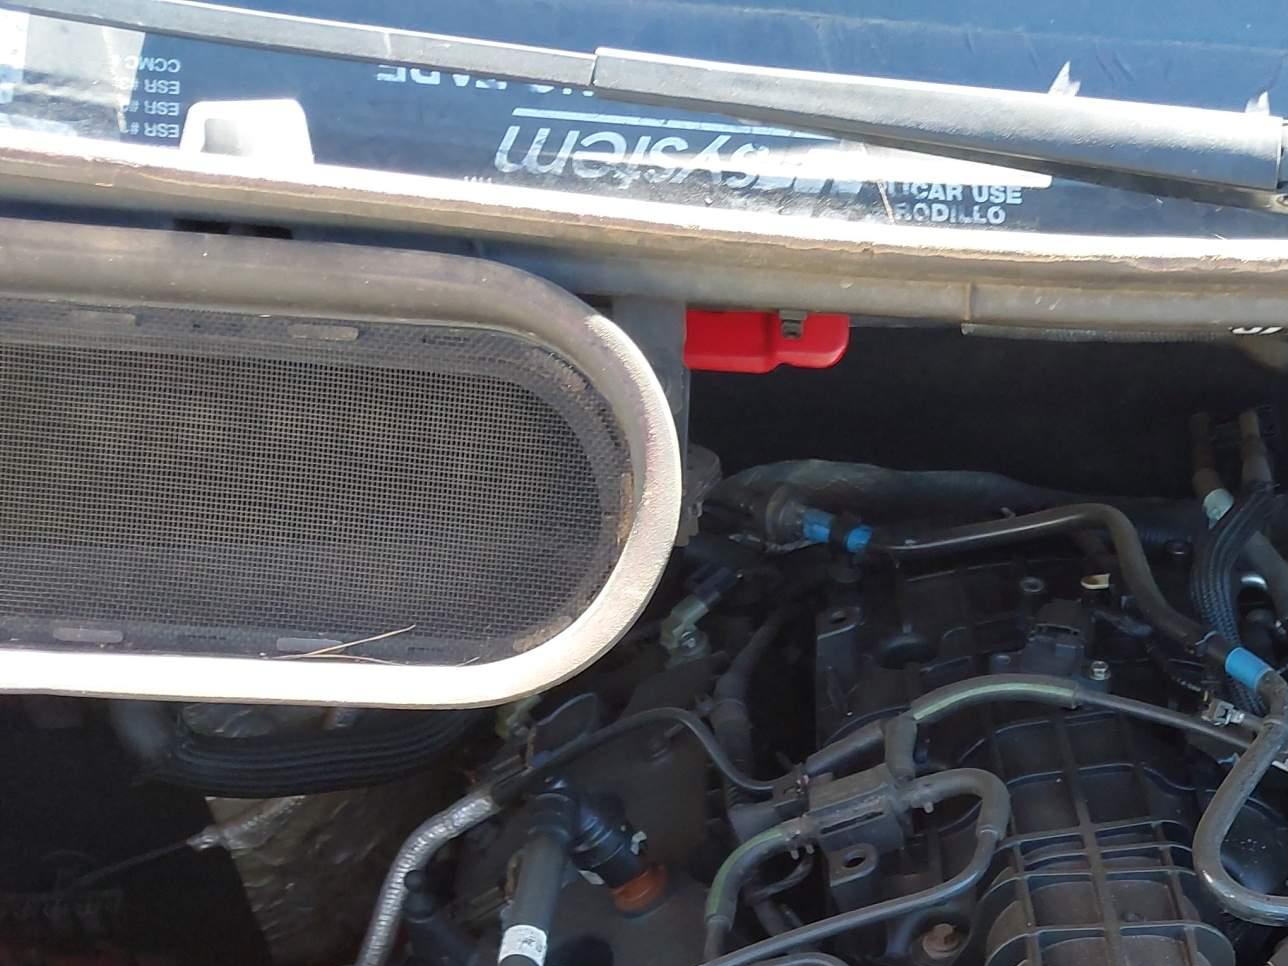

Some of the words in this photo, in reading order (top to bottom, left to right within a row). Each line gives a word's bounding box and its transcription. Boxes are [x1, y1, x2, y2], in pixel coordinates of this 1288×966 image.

[144, 79, 180, 94] ESR
[144, 100, 180, 115] ESR
[144, 122, 180, 138] ESR
[972, 184, 1022, 204] USE
